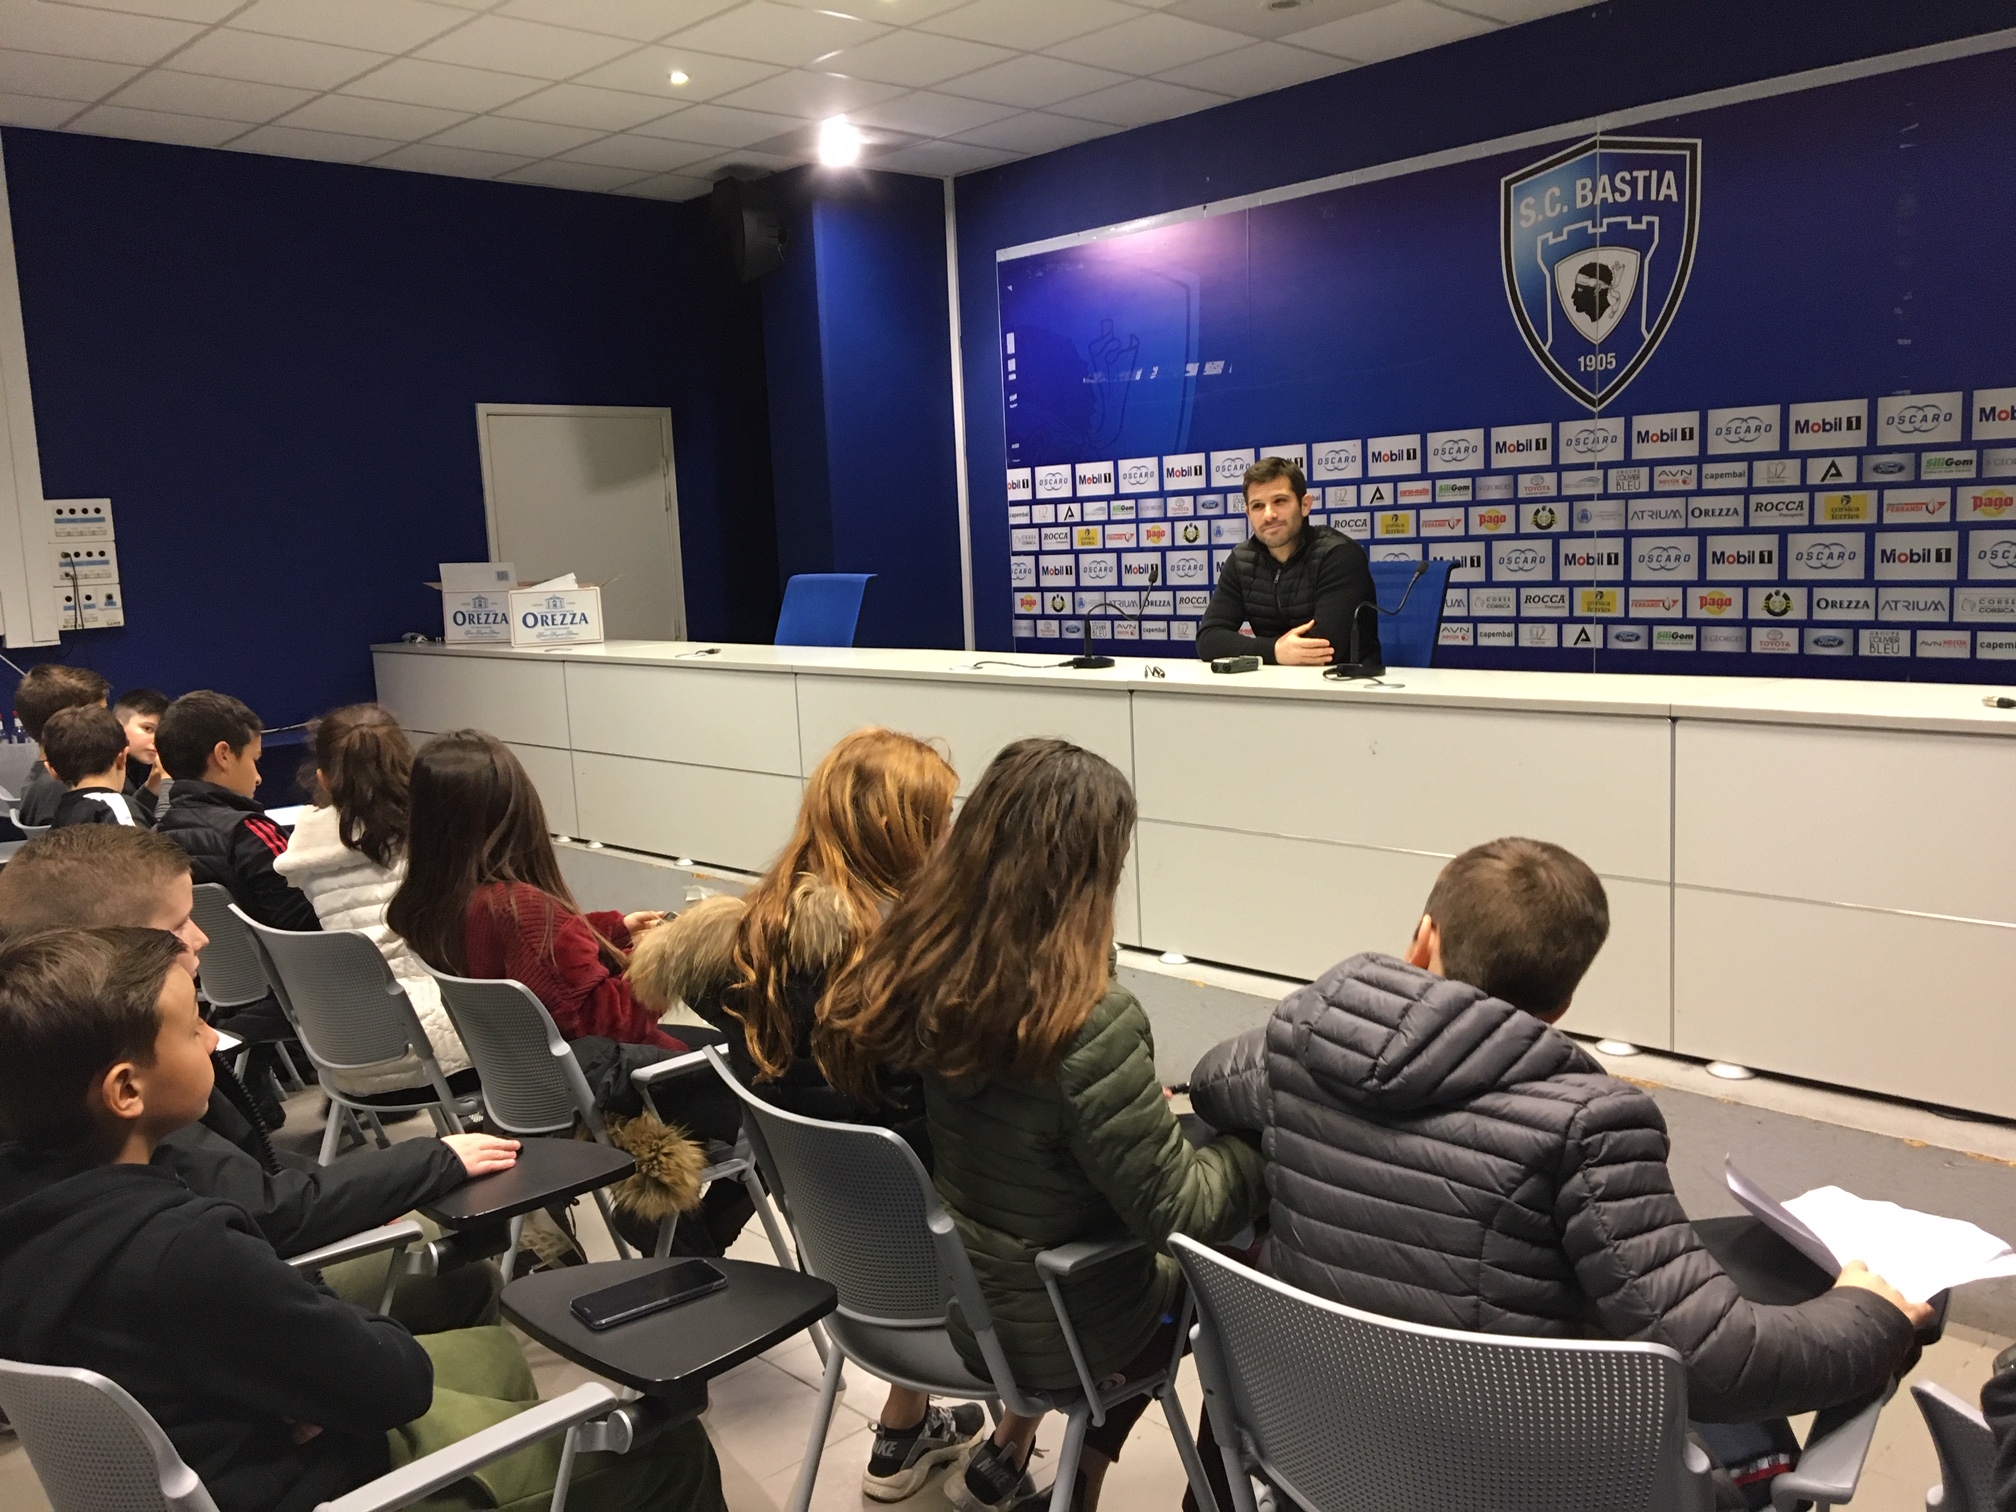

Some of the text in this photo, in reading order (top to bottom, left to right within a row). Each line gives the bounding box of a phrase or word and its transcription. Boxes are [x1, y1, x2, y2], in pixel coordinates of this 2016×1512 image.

[1519, 170, 1678, 228] S.C. BASTIA
[1577, 353, 1617, 372] 1905
[1794, 416, 1861, 434] Mobil 1
[1886, 412, 1952, 426] OSCARO
[1636, 427, 1694, 444] Mobil 1
[1715, 423, 1772, 436] OSCARO
[1495, 438, 1547, 454] Mobil 1
[1566, 435, 1617, 447] OSCARO
[1371, 448, 1417, 463] Mobil 1
[1433, 445, 1478, 456] OSCARO
[1317, 455, 1357, 465] OSCARO
[1122, 471, 1155, 480] OSCARO
[1166, 465, 1203, 478] Mobil 1
[1658, 469, 1693, 477] AVN
[1704, 471, 1746, 481] capembal
[1039, 477, 1068, 486] OSCARO
[1079, 473, 1112, 485] Mobil 1
[1616, 481, 1641, 491] BLEU
[1754, 500, 1805, 512] ROCCA
[1971, 493, 2014, 512] pago
[1631, 509, 1683, 521] ATRIUM
[1691, 506, 1739, 519] OREZZA
[1334, 518, 1368, 529] ROCCA
[1478, 514, 1507, 527] pago
[1043, 532, 1068, 541] ROCCA
[1146, 529, 1166, 540] pago
[1499, 556, 1546, 565] OSCARO
[1564, 552, 1619, 566] Mobil 1
[1638, 553, 1691, 563] OSCARO
[1711, 550, 1773, 565] Mobil 1
[1795, 551, 1857, 561] OSCARO
[1880, 547, 1952, 564] Mobil 1
[1170, 564, 1204, 572] OSCARO
[1470, 556, 1481, 568] 1
[1042, 565, 1073, 576] Mobil 1
[1124, 564, 1149, 574] Mobil
[1179, 596, 1207, 605] ROCCA
[1524, 594, 1566, 604] ROCCA
[1698, 595, 1733, 609] pago
[1816, 598, 1870, 610] OREZZA
[1881, 600, 1946, 612] ATRIUM
[452, 610, 509, 626] OREZZA
[522, 612, 589, 629] OREZZA
[1479, 630, 1513, 639] capembal
[1869, 643, 1900, 654] BLEU
